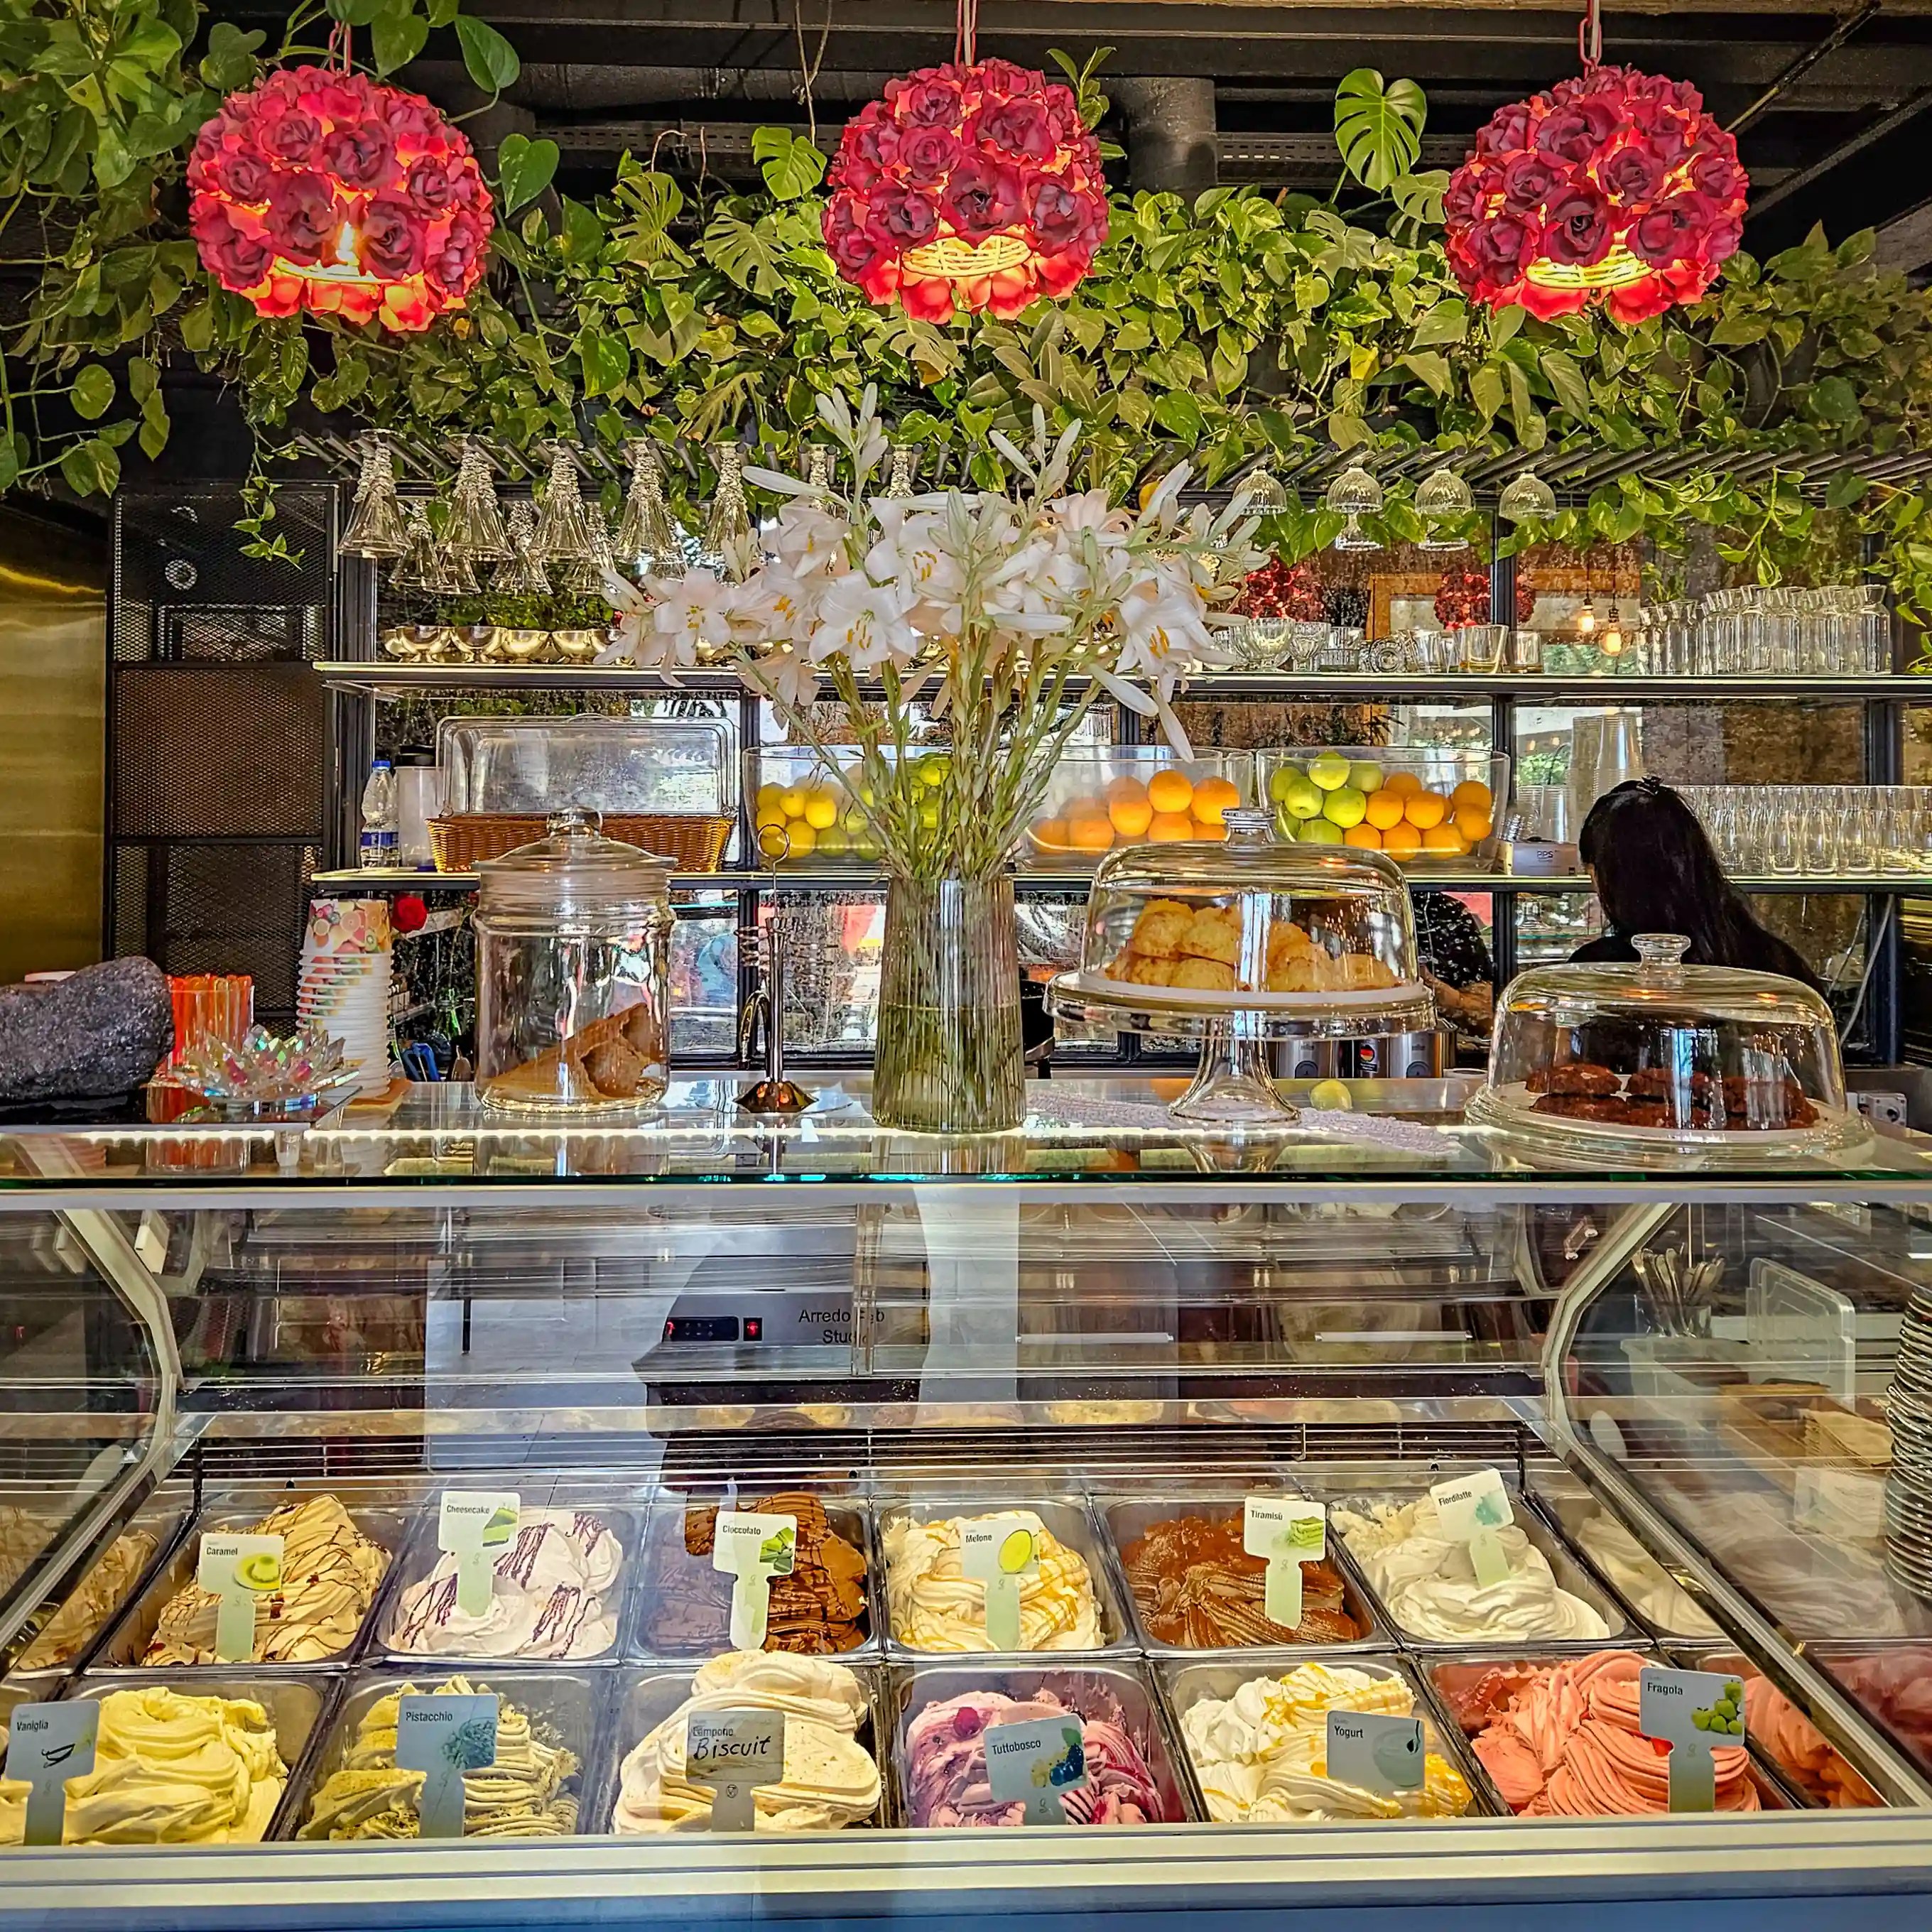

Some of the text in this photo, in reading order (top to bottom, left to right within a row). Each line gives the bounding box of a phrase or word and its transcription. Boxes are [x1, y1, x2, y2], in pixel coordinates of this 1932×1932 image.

[798, 1308, 851, 1323] Arredo
[1438, 1492, 1472, 1506] Fiordilatte
[447, 1504, 490, 1514] Cheesecake
[1251, 1510, 1283, 1520] Tiramisù
[722, 1525, 761, 1535] Cioccolato
[966, 1534, 992, 1543] Melone
[207, 1547, 238, 1556] Caramel
[1647, 1682, 1683, 1695] Fragola
[406, 1711, 453, 1722] Pistacchio
[16, 1719, 49, 1732] Vaniglia
[1334, 1725, 1364, 1739] Yogurt
[693, 1735, 771, 1760] Biscuit
[992, 1740, 1041, 1754] Tuttobosco
